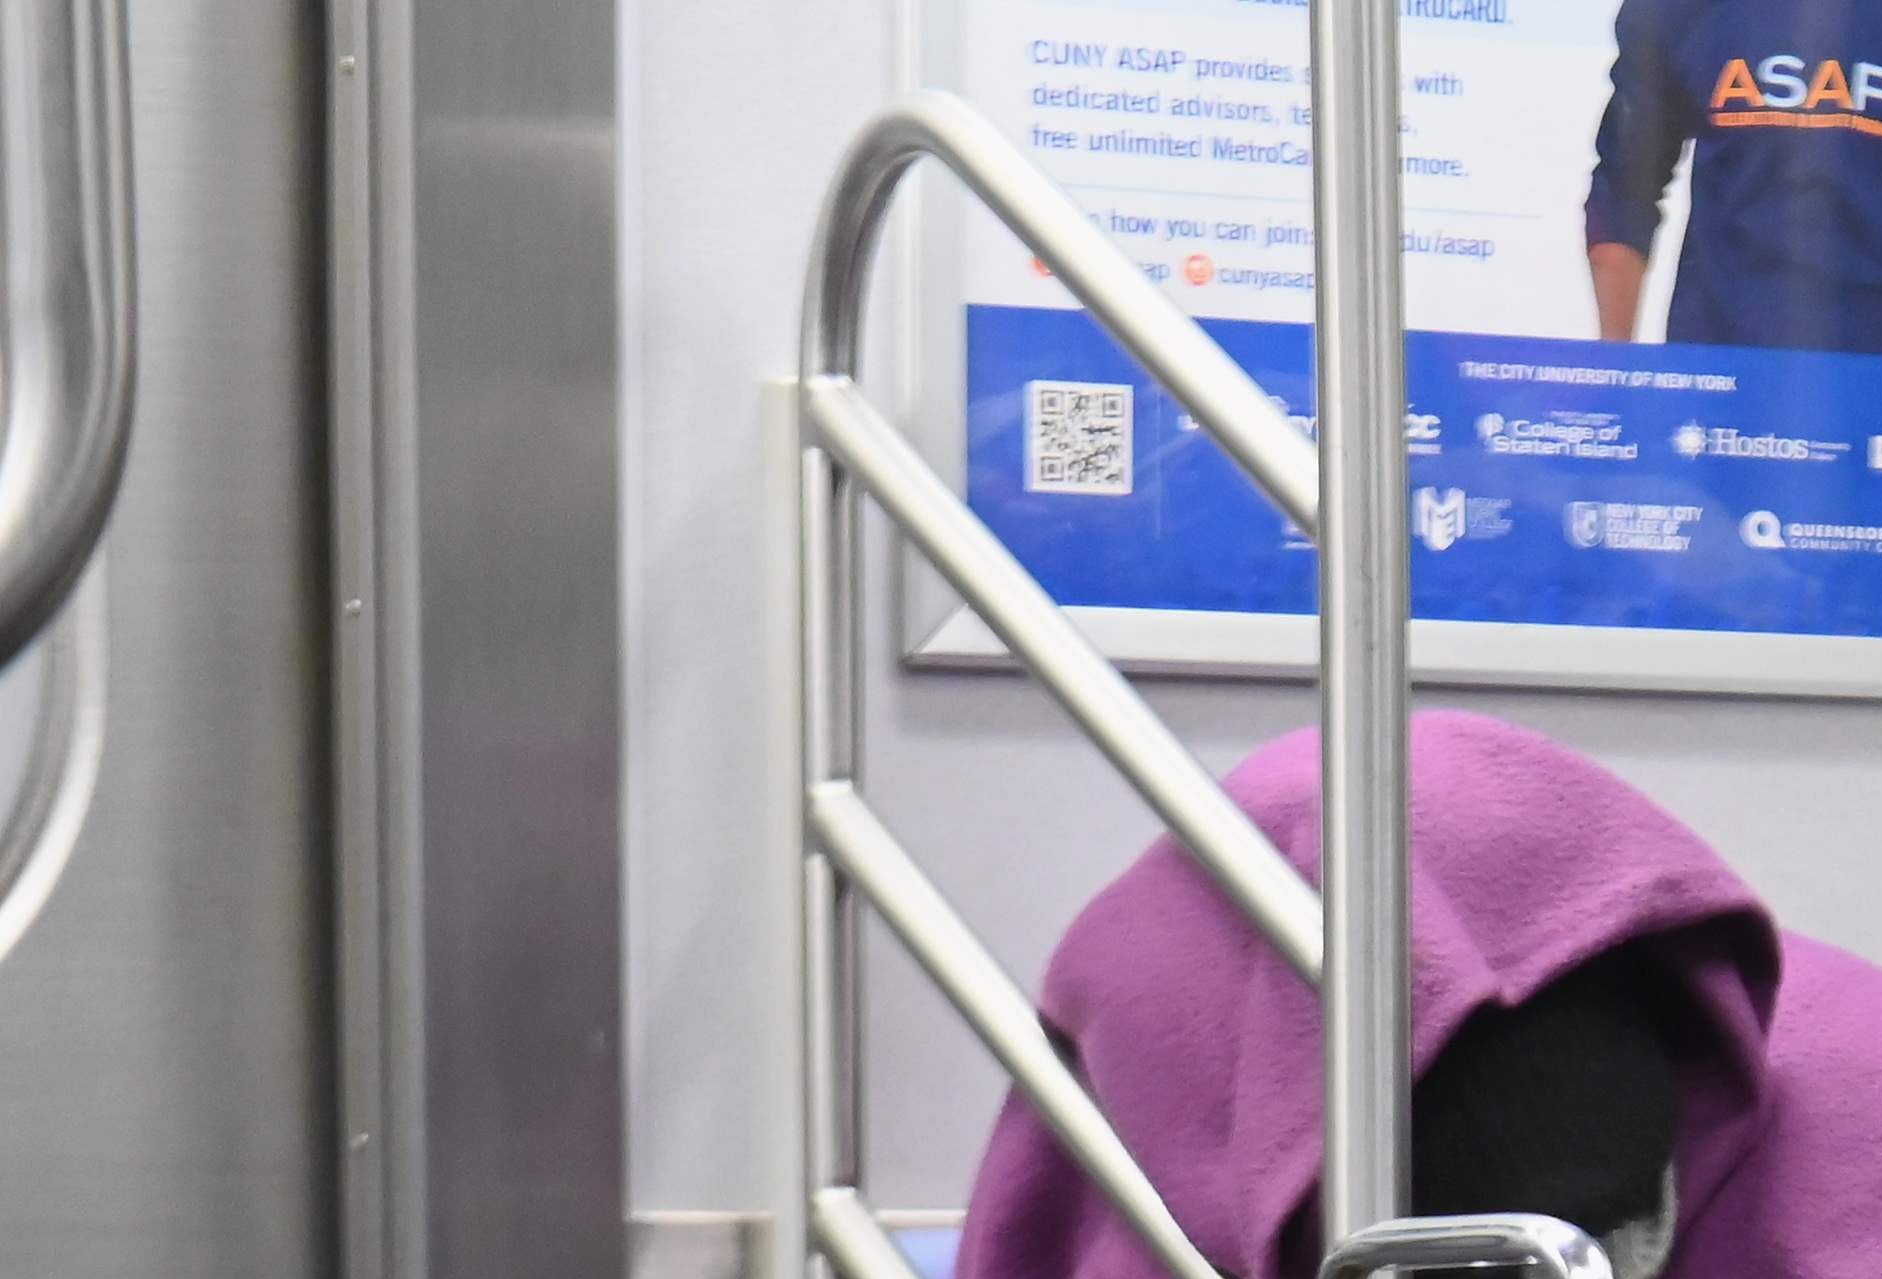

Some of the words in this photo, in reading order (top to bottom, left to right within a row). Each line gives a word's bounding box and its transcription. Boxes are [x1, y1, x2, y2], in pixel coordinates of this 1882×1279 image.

[1031, 40, 1107, 67] CUNY
[1118, 46, 1185, 72] ASAP
[1195, 58, 1294, 82] provides
[1031, 83, 1160, 115] dedicated
[1413, 69, 1465, 97] with
[1031, 123, 1078, 150] free
[1089, 129, 1201, 158] unlimited
[1111, 209, 1156, 234] how
[1165, 218, 1206, 242] you
[1215, 222, 1257, 241] can
[1459, 360, 1498, 379] THE
[1500, 362, 1536, 380] CITY
[1537, 365, 1629, 387] UNIVERSITY
[1631, 371, 1653, 387] OF
[1654, 371, 1693, 390] NEW
[1695, 373, 1738, 392] YORK
[1511, 419, 1594, 444] College
[1599, 424, 1623, 442] of
[1708, 425, 1809, 460] Hostos
[1490, 435, 1570, 457] Staten
[1575, 441, 1639, 461] Island
[1605, 501, 1635, 520] NEW
[1637, 502, 1674, 521] YORK
[1674, 504, 1704, 523] CITY
[1789, 537, 1872, 553] COMMUNITY
